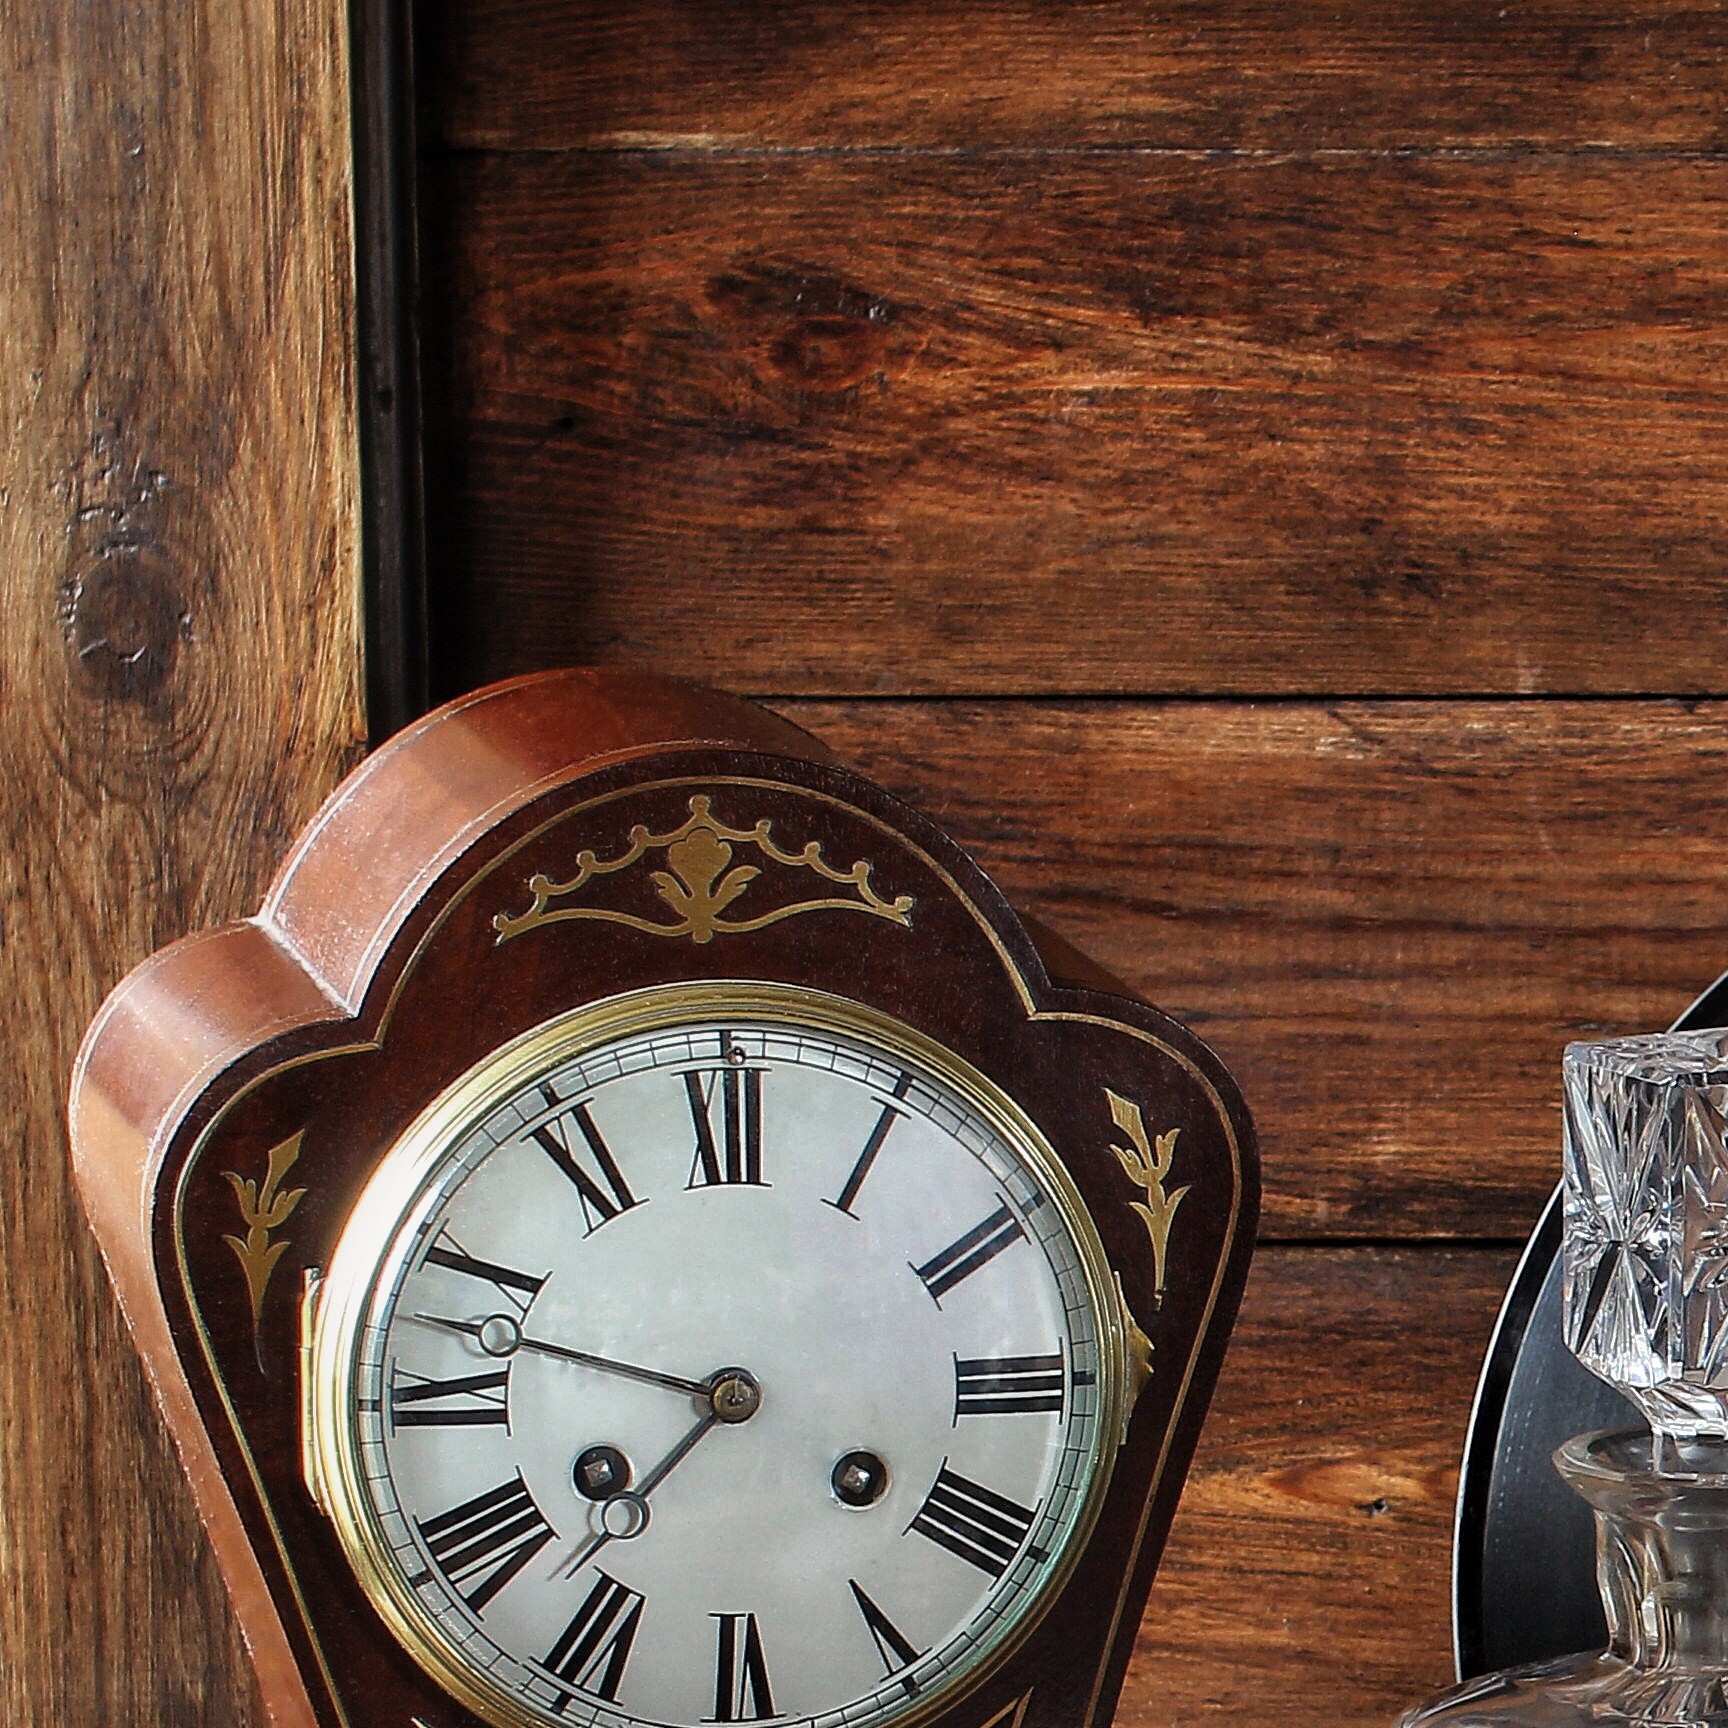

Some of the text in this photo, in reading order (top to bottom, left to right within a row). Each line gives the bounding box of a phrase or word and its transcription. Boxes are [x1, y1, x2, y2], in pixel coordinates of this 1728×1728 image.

[520, 1096, 650, 1240] XI
[674, 1067, 772, 1191] XII
[821, 1094, 910, 1221] I
[416, 1217, 553, 1314] X
[908, 1192, 1031, 1310] II
[392, 1355, 512, 1438] IX
[953, 1336, 1064, 1430] III
[413, 1463, 561, 1618] VIII
[520, 1567, 648, 1711] VII
[700, 1612, 787, 1724] VI
[847, 1577, 933, 1686] V
